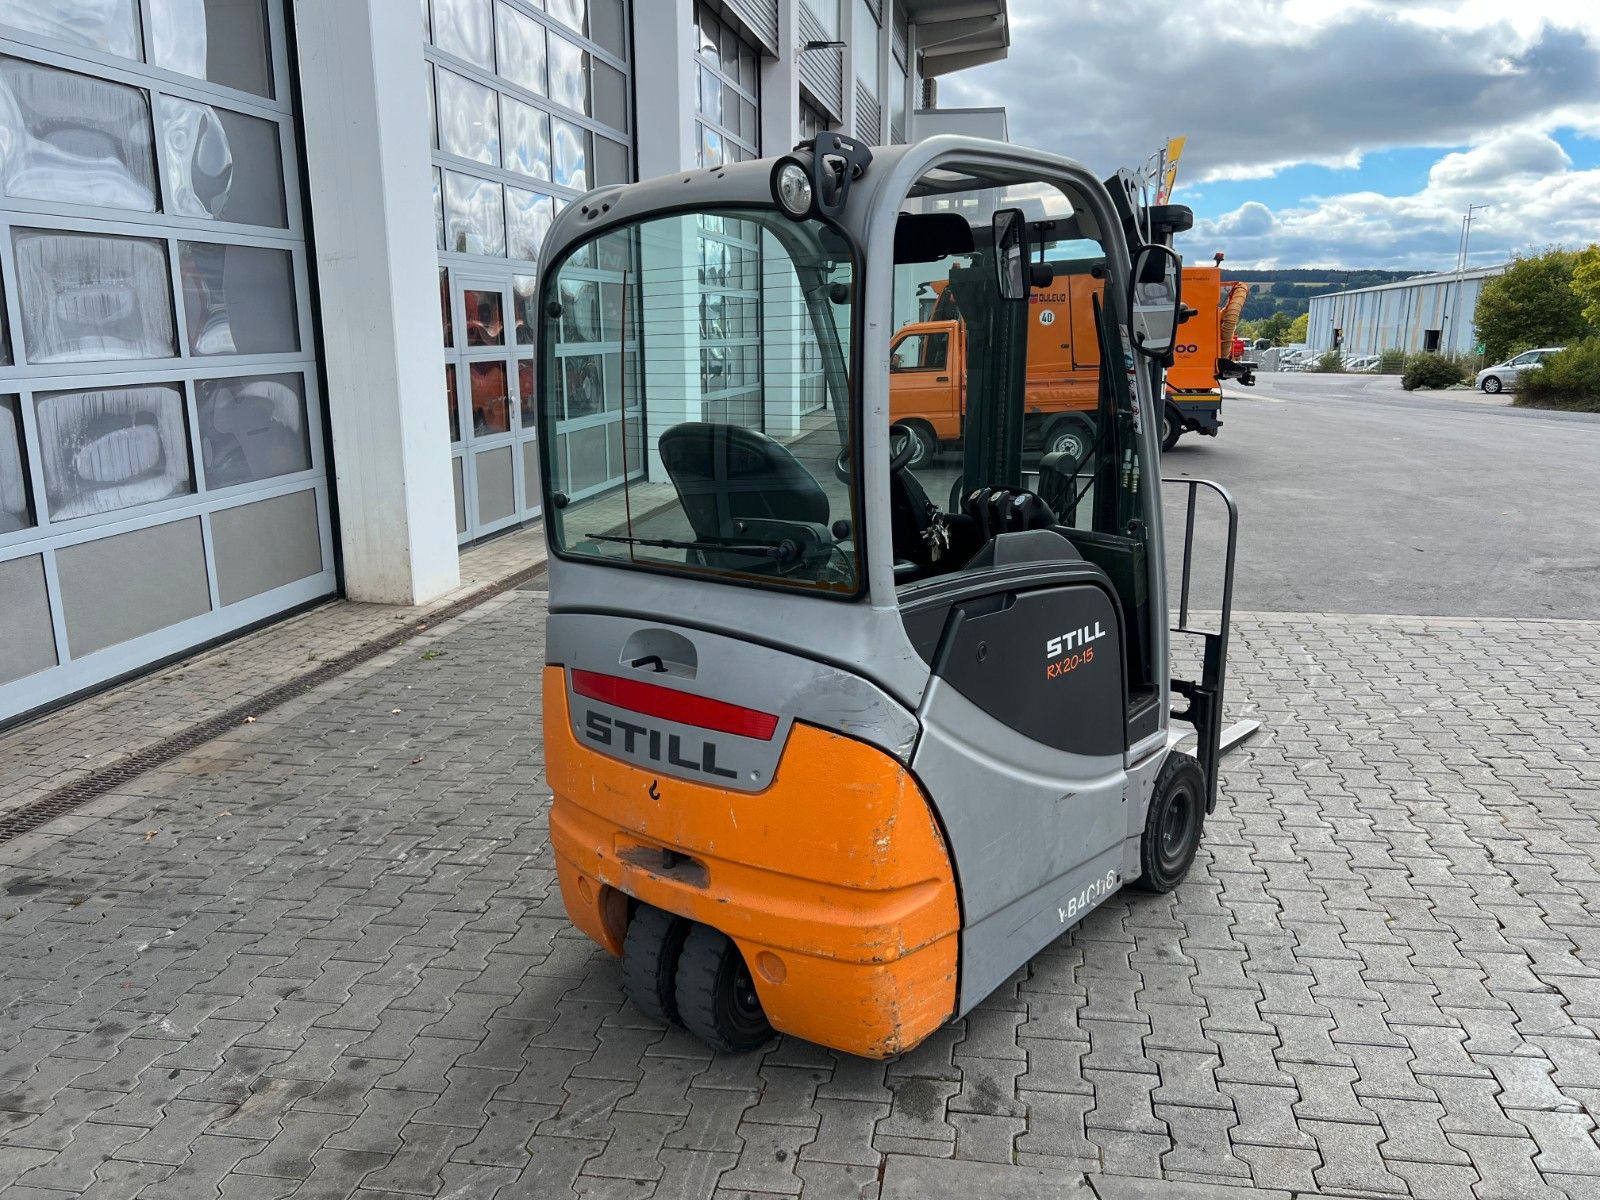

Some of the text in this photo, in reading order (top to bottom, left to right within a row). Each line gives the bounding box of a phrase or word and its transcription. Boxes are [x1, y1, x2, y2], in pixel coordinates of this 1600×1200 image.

[1039, 293, 1066, 303] DULEVO
[1041, 312, 1053, 323] 40
[1047, 621, 1106, 659] STILL
[1046, 647, 1094, 680] RX20-15
[586, 710, 738, 779] STILL
